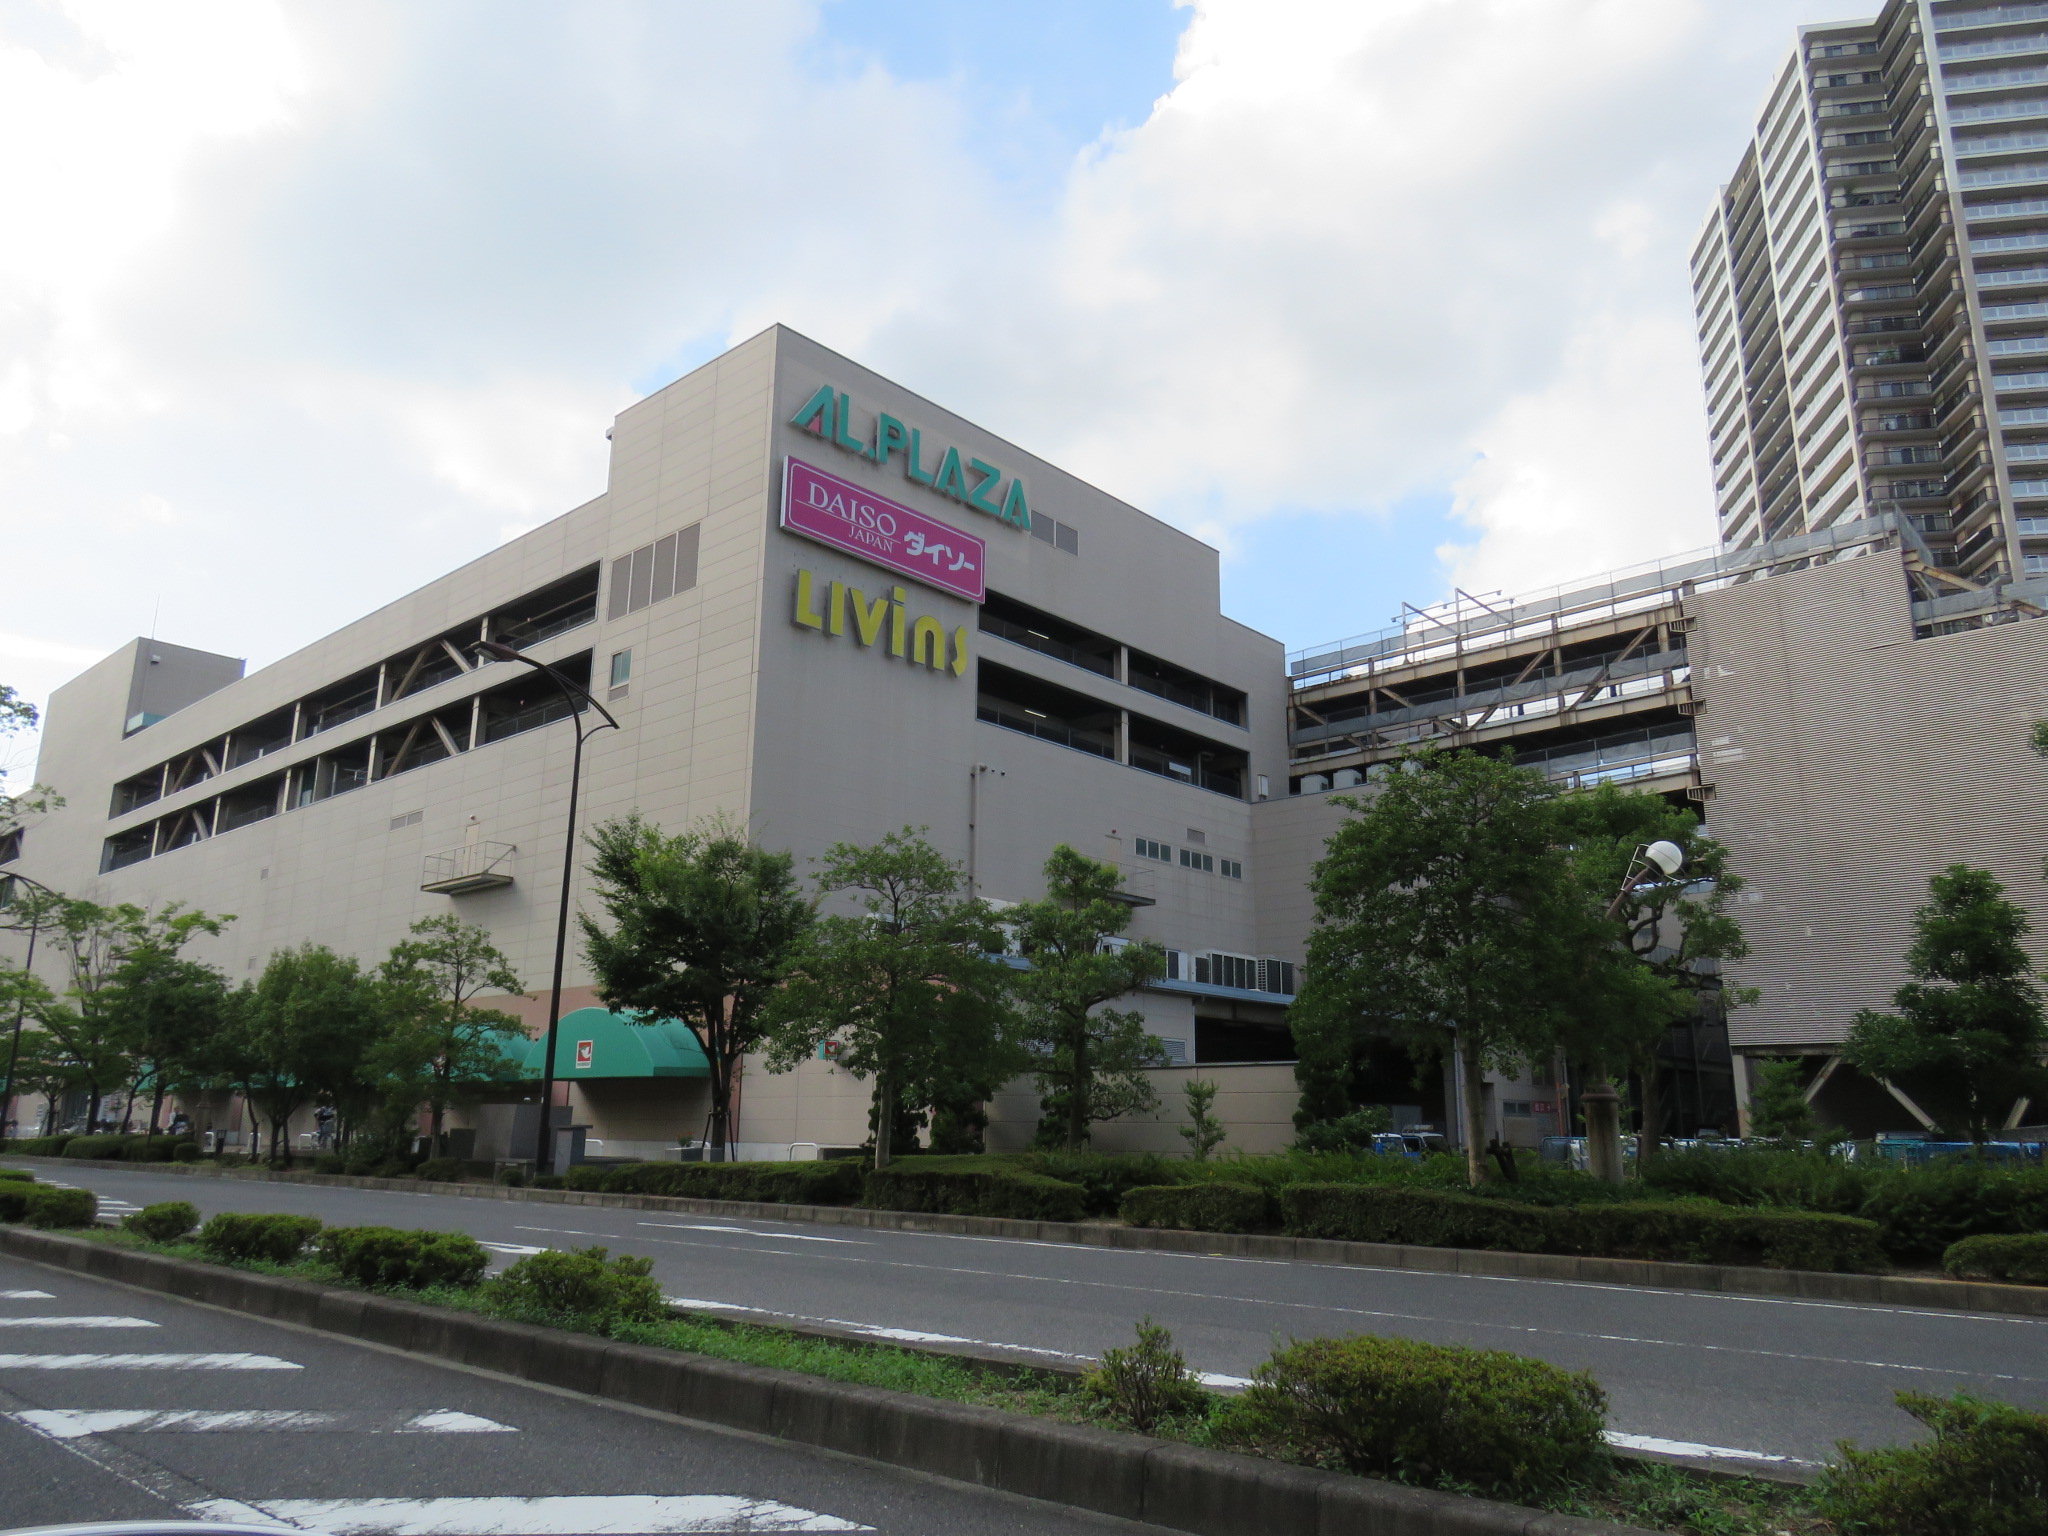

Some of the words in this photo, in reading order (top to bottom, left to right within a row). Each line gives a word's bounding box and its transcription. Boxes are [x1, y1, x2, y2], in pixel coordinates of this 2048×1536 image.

[791, 384, 1031, 531] AL.PLAZA
[808, 482, 897, 536] DAISO
[848, 526, 894, 554] JAPAN
[904, 530, 975, 571] ダイソー
